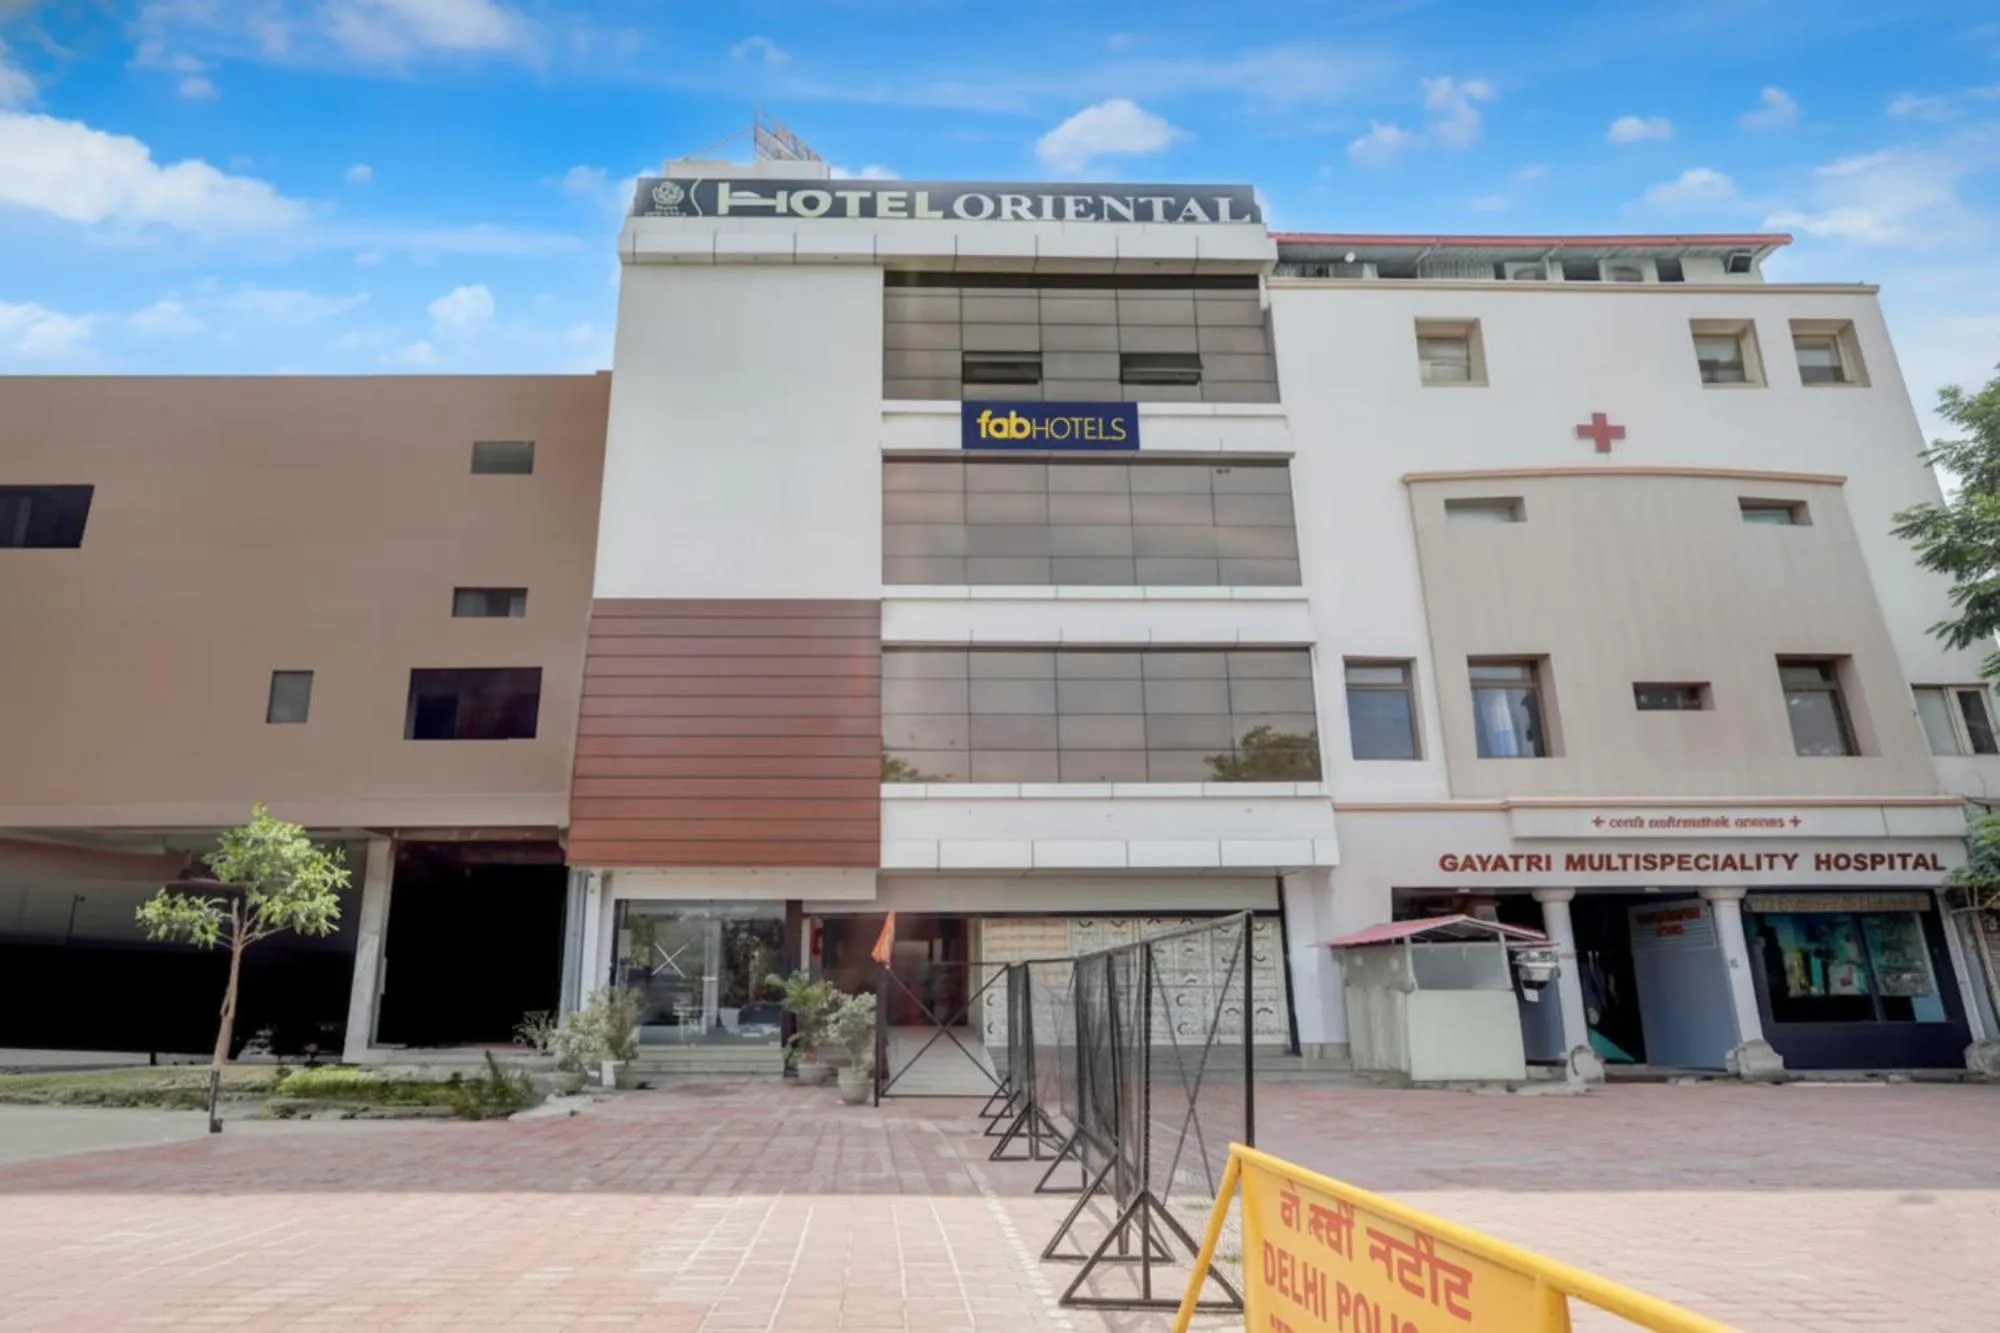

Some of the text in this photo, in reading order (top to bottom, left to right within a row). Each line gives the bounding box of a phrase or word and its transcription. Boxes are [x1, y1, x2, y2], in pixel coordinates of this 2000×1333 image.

[717, 181, 1250, 222] HOTEL ORIENTAL
[1438, 852, 1947, 873] GAYATRI MULTISPECIALITY HOSPITAL
[1263, 1238, 1419, 1333] DELHI POL
